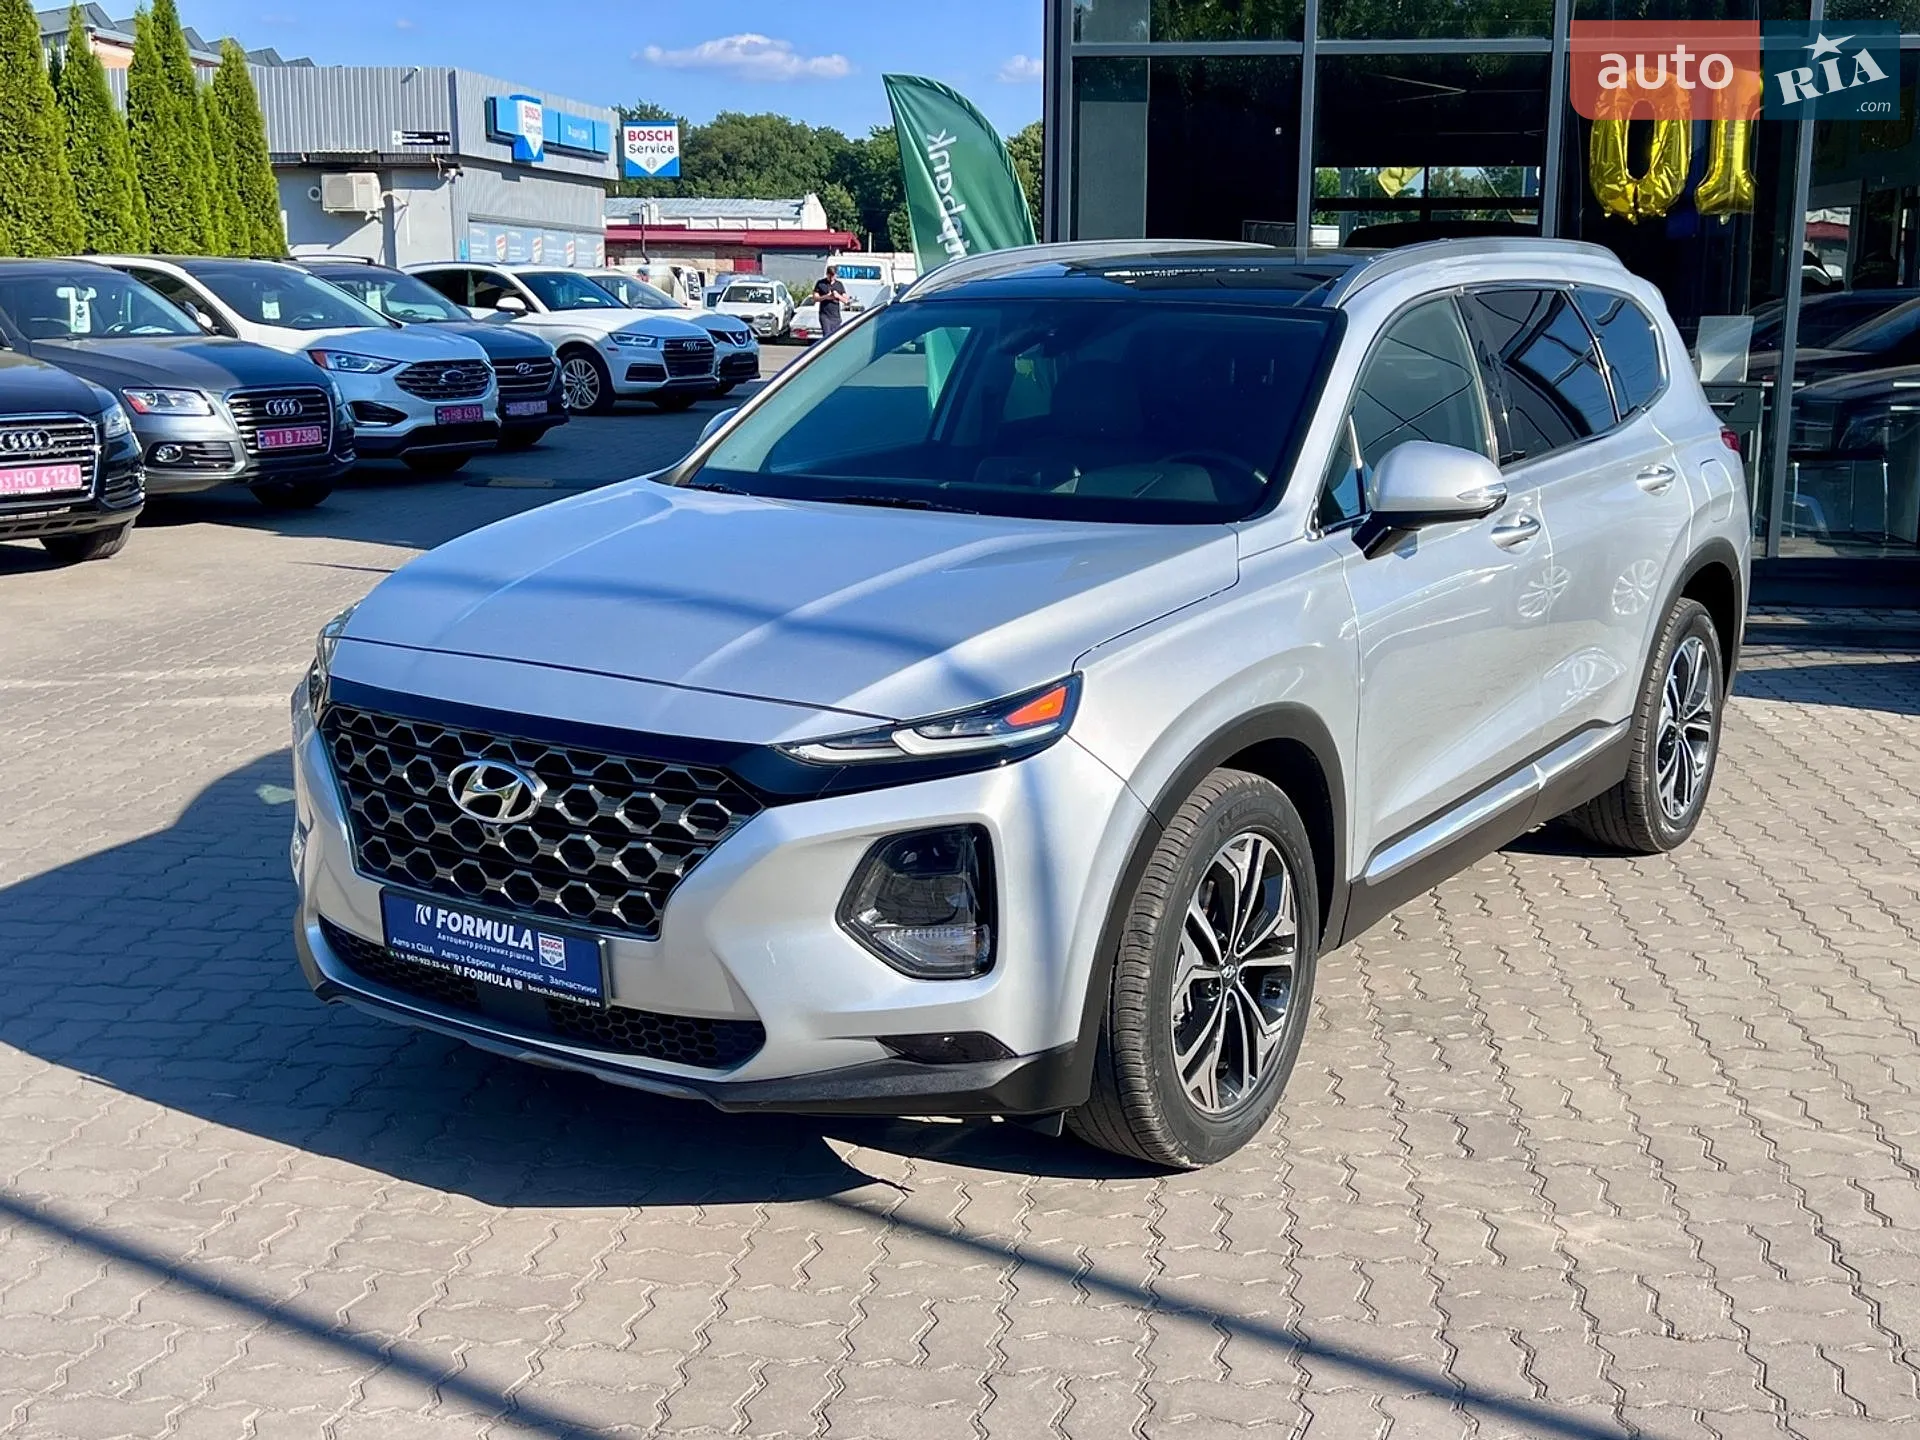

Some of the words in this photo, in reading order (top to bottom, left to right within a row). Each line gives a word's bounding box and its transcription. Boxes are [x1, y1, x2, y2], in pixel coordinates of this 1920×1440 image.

[628, 129, 673, 142] BOSCH
[628, 143, 675, 155] Service
[436, 908, 534, 951] FORMULA
[392, 937, 410, 950] Авто
[416, 942, 434, 955] США
[437, 932, 474, 951] Автоцентр
[441, 949, 460, 962] Авто
[465, 954, 496, 970] Європи
[464, 966, 512, 990] FORMULA
[500, 964, 544, 983] Автосервіс
[549, 975, 597, 995] Запчастини
